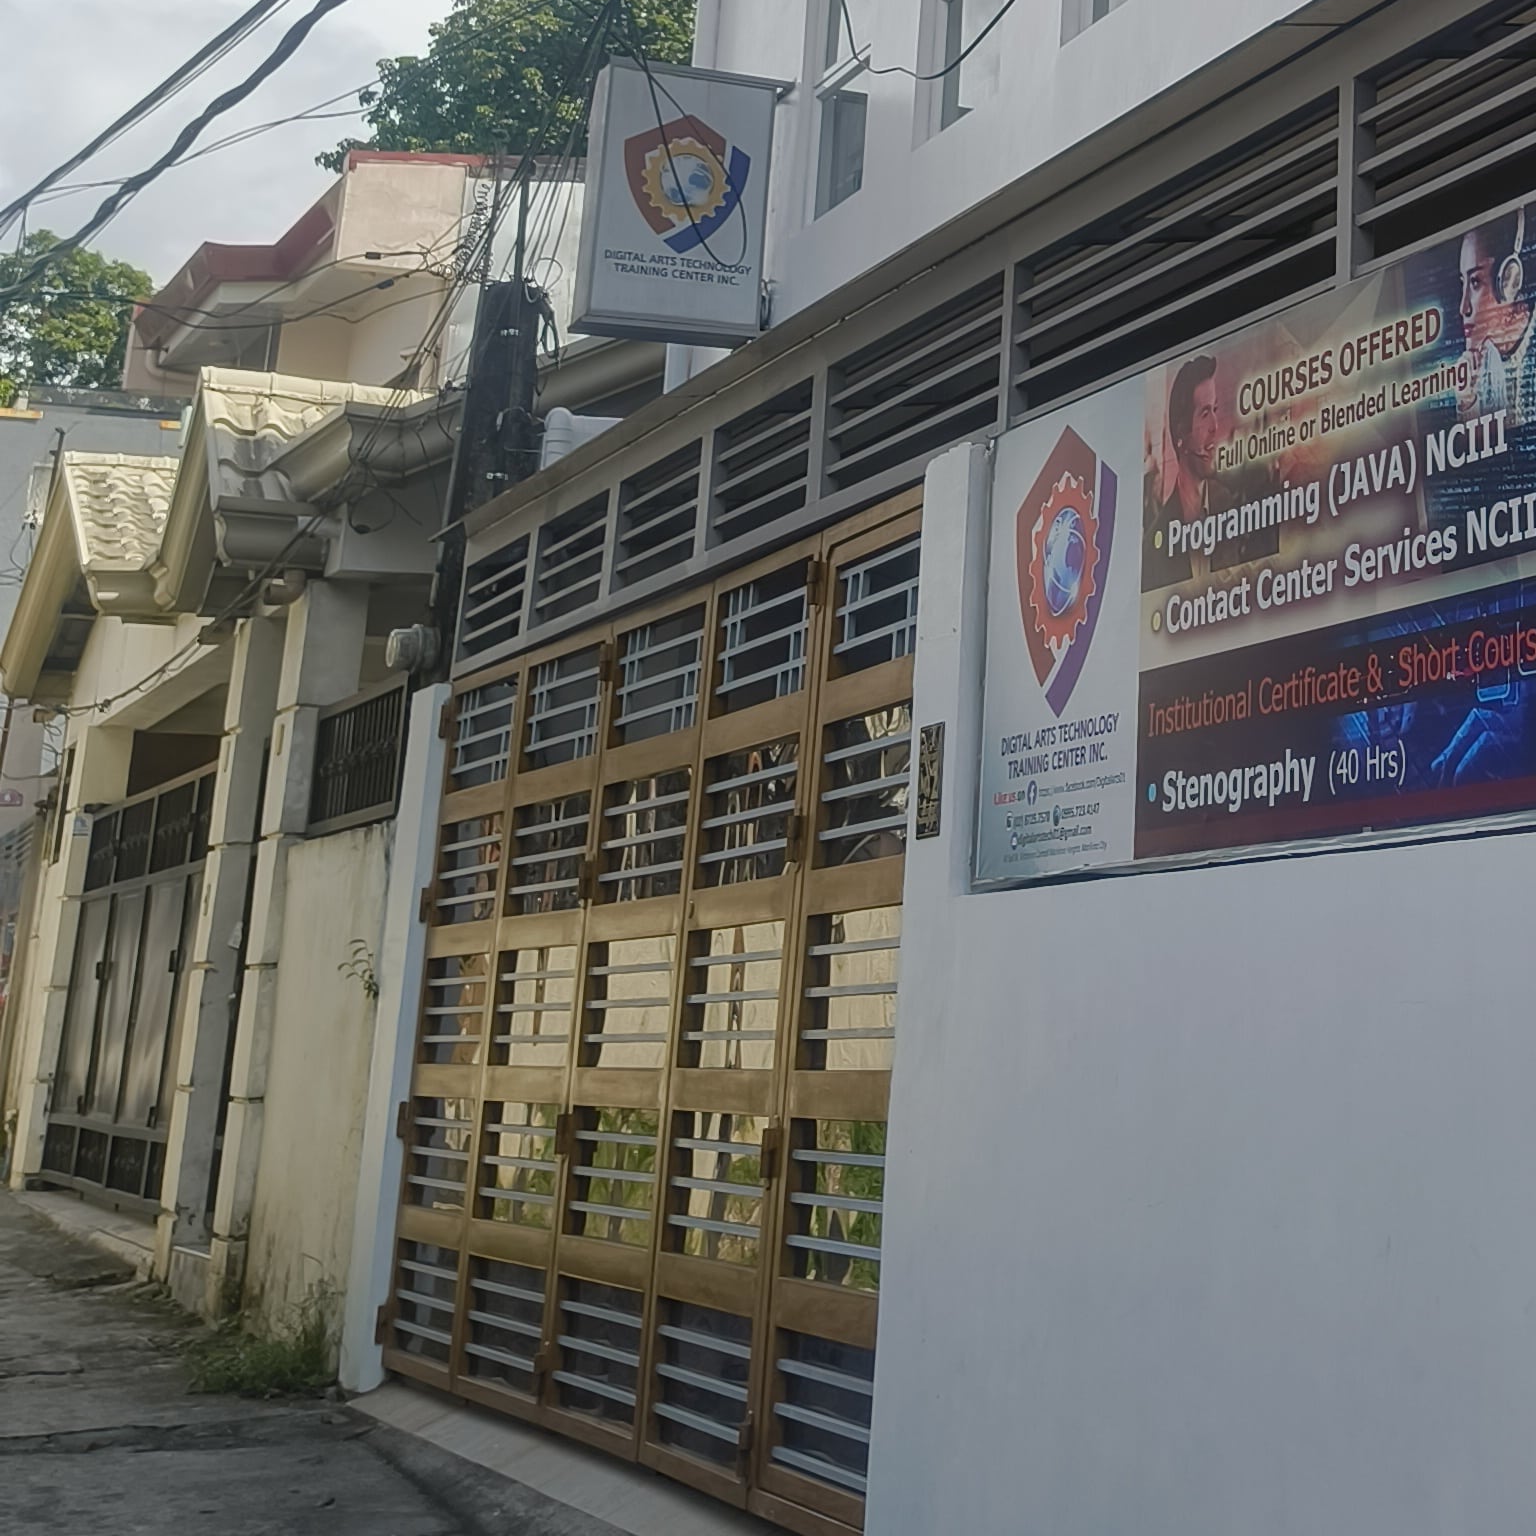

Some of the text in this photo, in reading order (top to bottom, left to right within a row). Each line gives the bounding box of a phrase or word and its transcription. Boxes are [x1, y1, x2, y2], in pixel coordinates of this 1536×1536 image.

[604, 249, 752, 276] DIGITAL ARTS TECHNOLOGY
[614, 262, 740, 286] TRAINING CENTER INC.
[1239, 308, 1441, 415] COURSES OFFERED
[1217, 362, 1468, 471] Full Online or Blended Learning
[1168, 409, 1508, 557] Programming (JAVA) NCIII
[1166, 492, 1536, 633] Contact Center Services NCII
[1148, 680, 1252, 737] Institutional
[1259, 662, 1360, 714] Certificate
[1367, 654, 1383, 693] &
[1399, 638, 1459, 687] Short
[1001, 712, 1119, 756] DIGITAL ARTS TECHNOLOGY
[1008, 742, 1108, 779] TRAINING CENTER INC.
[1162, 748, 1316, 813] Stenography
[1329, 750, 1359, 795] (40
[1366, 739, 1406, 785] Hrs)
